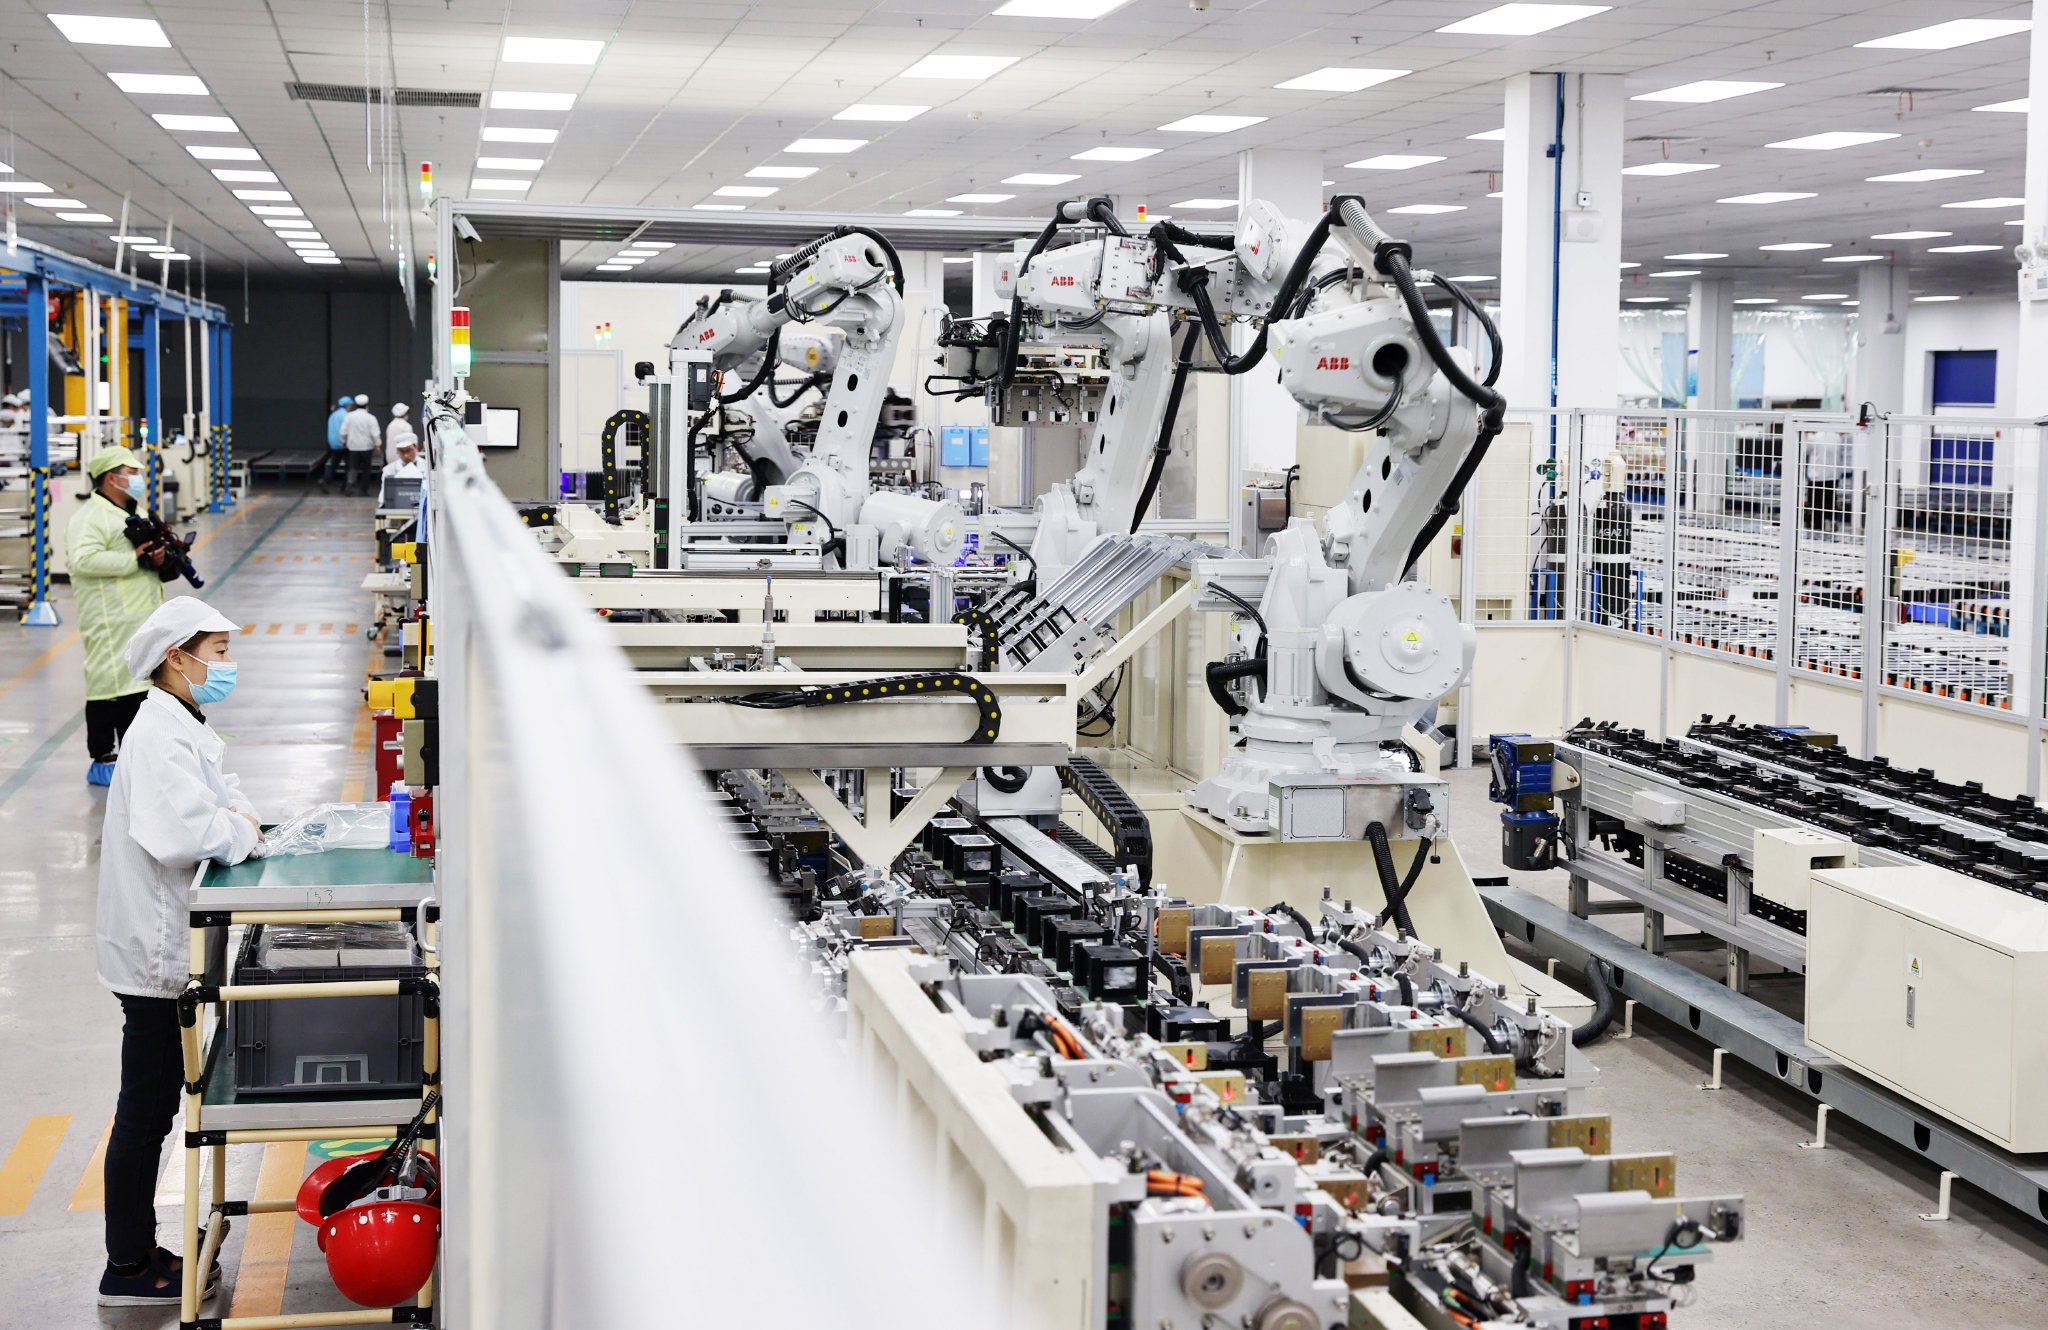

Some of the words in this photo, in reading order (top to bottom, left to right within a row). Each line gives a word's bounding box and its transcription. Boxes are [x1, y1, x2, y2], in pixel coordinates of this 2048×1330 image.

[1051, 276, 1075, 286] ABB
[699, 328, 715, 343] ABB
[1316, 356, 1349, 370] ABB
[306, 889, 334, 908] 153
